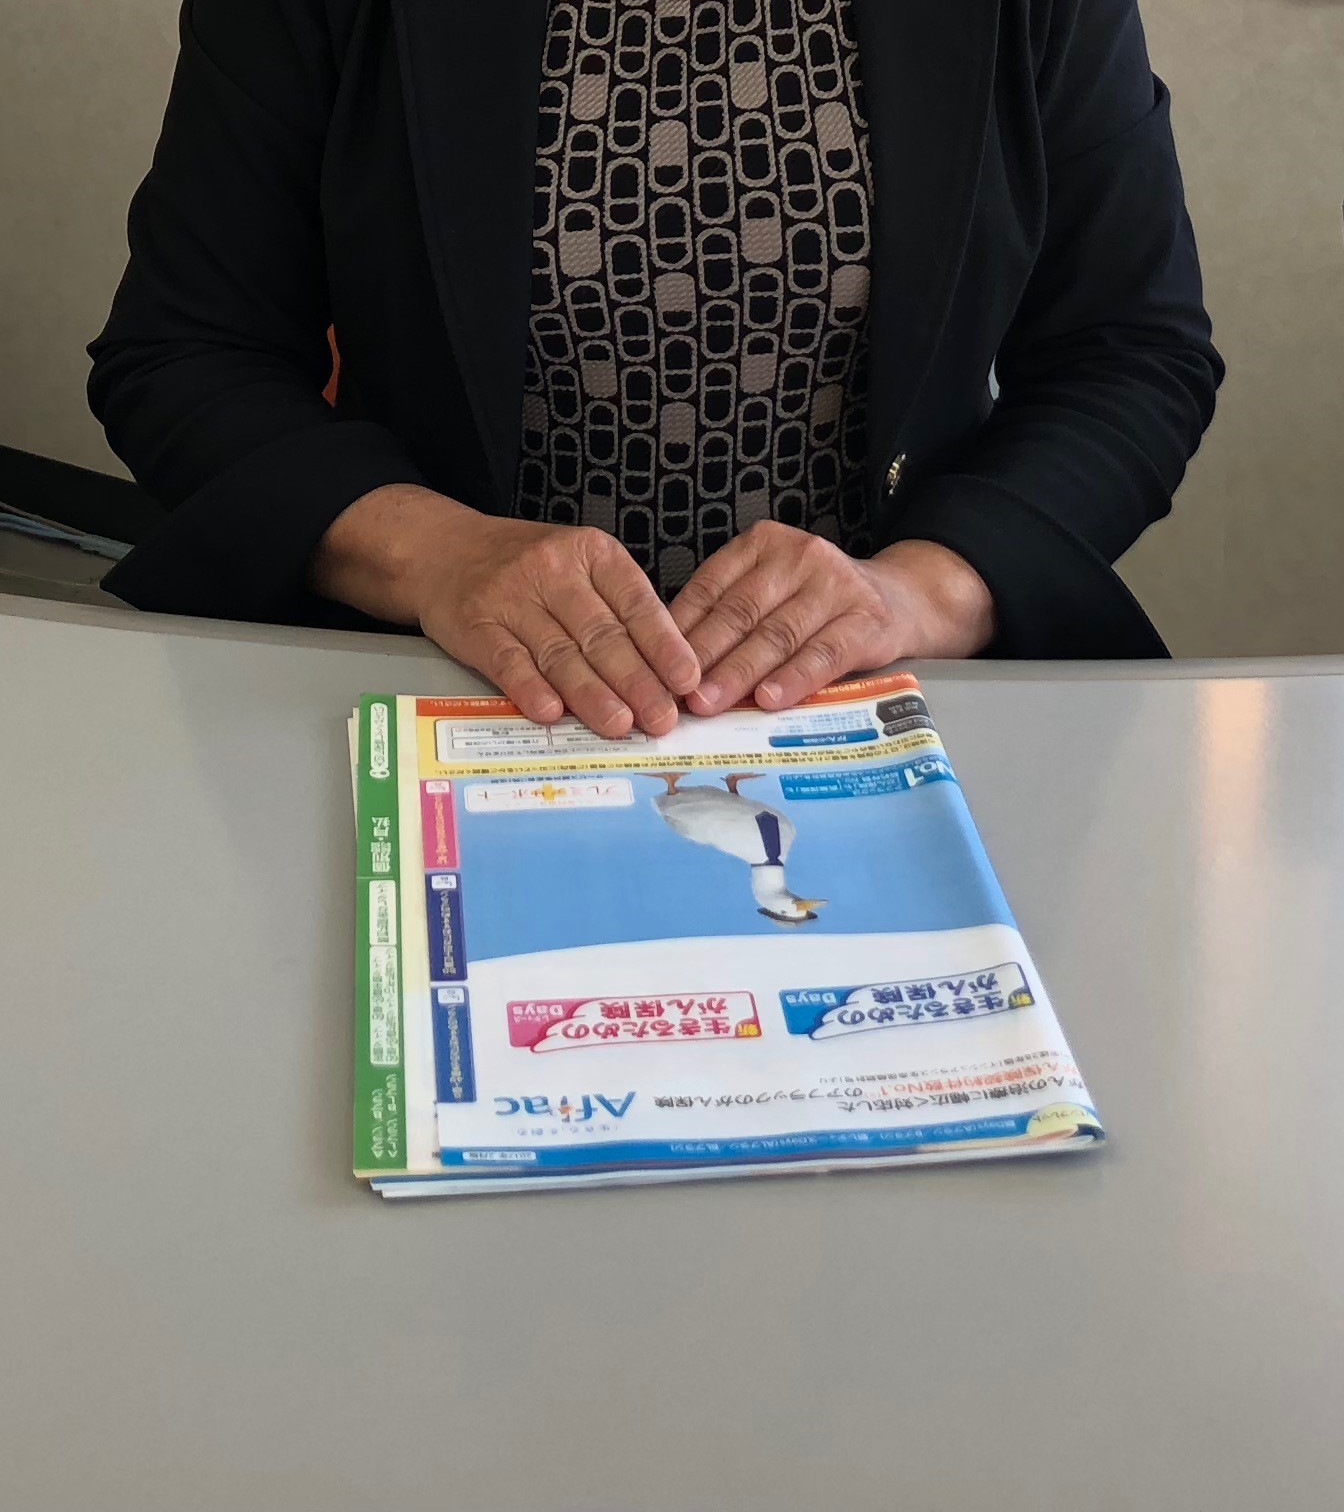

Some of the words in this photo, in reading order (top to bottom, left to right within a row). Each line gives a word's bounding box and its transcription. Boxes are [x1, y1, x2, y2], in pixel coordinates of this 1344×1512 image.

[785, 990, 836, 1006] Days
[870, 972, 998, 1002] がん保険
[513, 1002, 564, 1016] Days
[599, 997, 728, 1020] がん保険
[836, 990, 1004, 1026] 生きるための
[562, 1016, 731, 1040] 生きるための
[493, 1092, 637, 1123] Aflac
